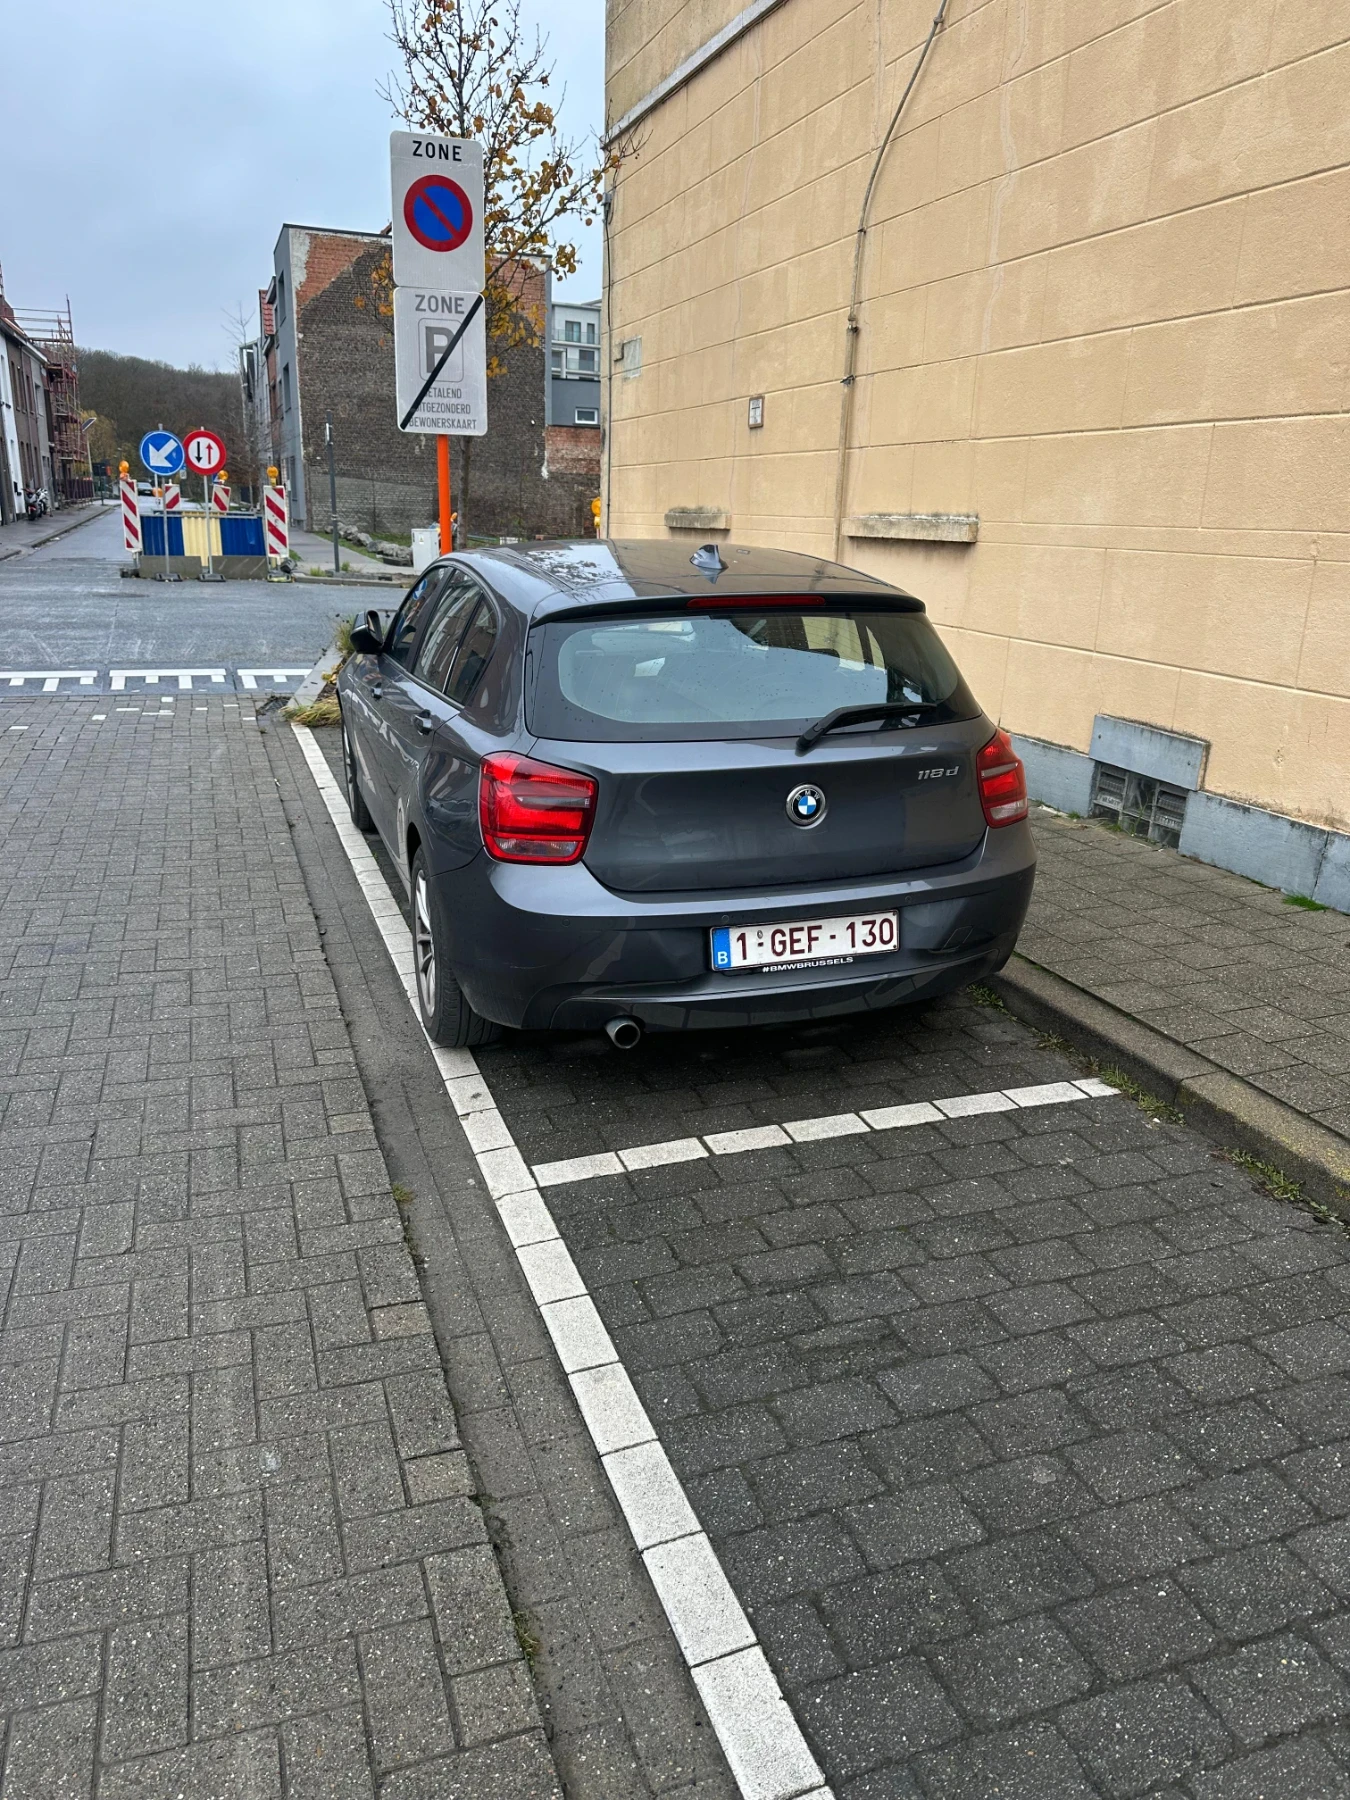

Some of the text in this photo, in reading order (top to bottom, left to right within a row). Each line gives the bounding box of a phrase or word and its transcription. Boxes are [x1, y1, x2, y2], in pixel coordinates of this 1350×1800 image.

[412, 140, 462, 162] ZONE
[414, 293, 465, 315] ZONE
[425, 325, 456, 375] P
[424, 387, 462, 399] ETALEND
[796, 790, 821, 801] BMW
[717, 951, 728, 965] B
[762, 956, 854, 974] #BMWBRUSSELS
